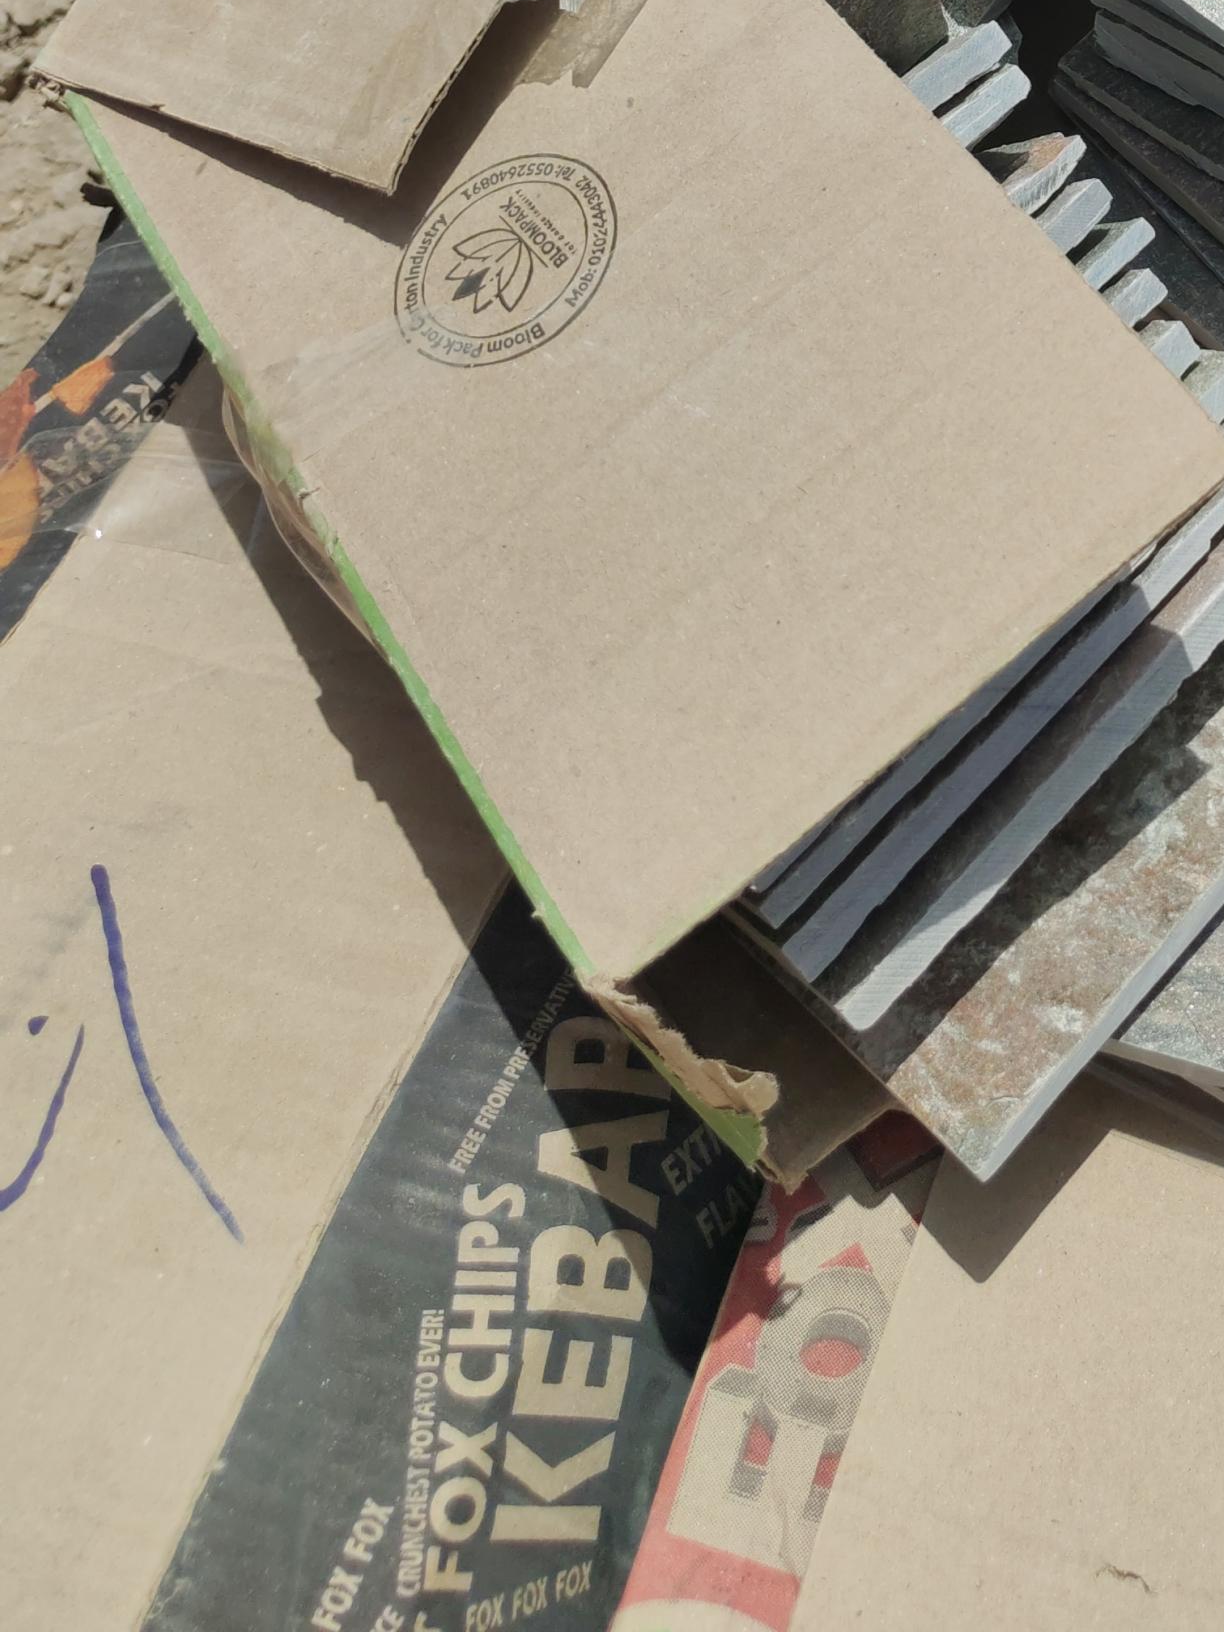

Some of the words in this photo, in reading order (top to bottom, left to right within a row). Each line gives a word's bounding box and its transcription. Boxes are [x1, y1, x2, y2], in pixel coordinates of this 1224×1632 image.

[402, 212, 450, 283] Industry
[499, 197, 569, 269] BLOOMPACK
[420, 325, 446, 349] for
[444, 340, 484, 359] Pack
[487, 322, 547, 354] Bloom
[448, 1123, 487, 1174] FREE
[477, 1071, 515, 1127] FROM
[659, 1124, 723, 1197] EXT
[443, 1182, 527, 1398] CHIPS
[417, 1308, 446, 1370] EVER!
[408, 1370, 439, 1462] POTATO
[396, 1462, 432, 1598] CRUNCHEST
[423, 1421, 499, 1592] FOX
[311, 1565, 364, 1632] FOX
[343, 1496, 395, 1563] FOX
[465, 1591, 506, 1632] FOX
[512, 1574, 548, 1621] FOX
[555, 1560, 593, 1603] FOX
